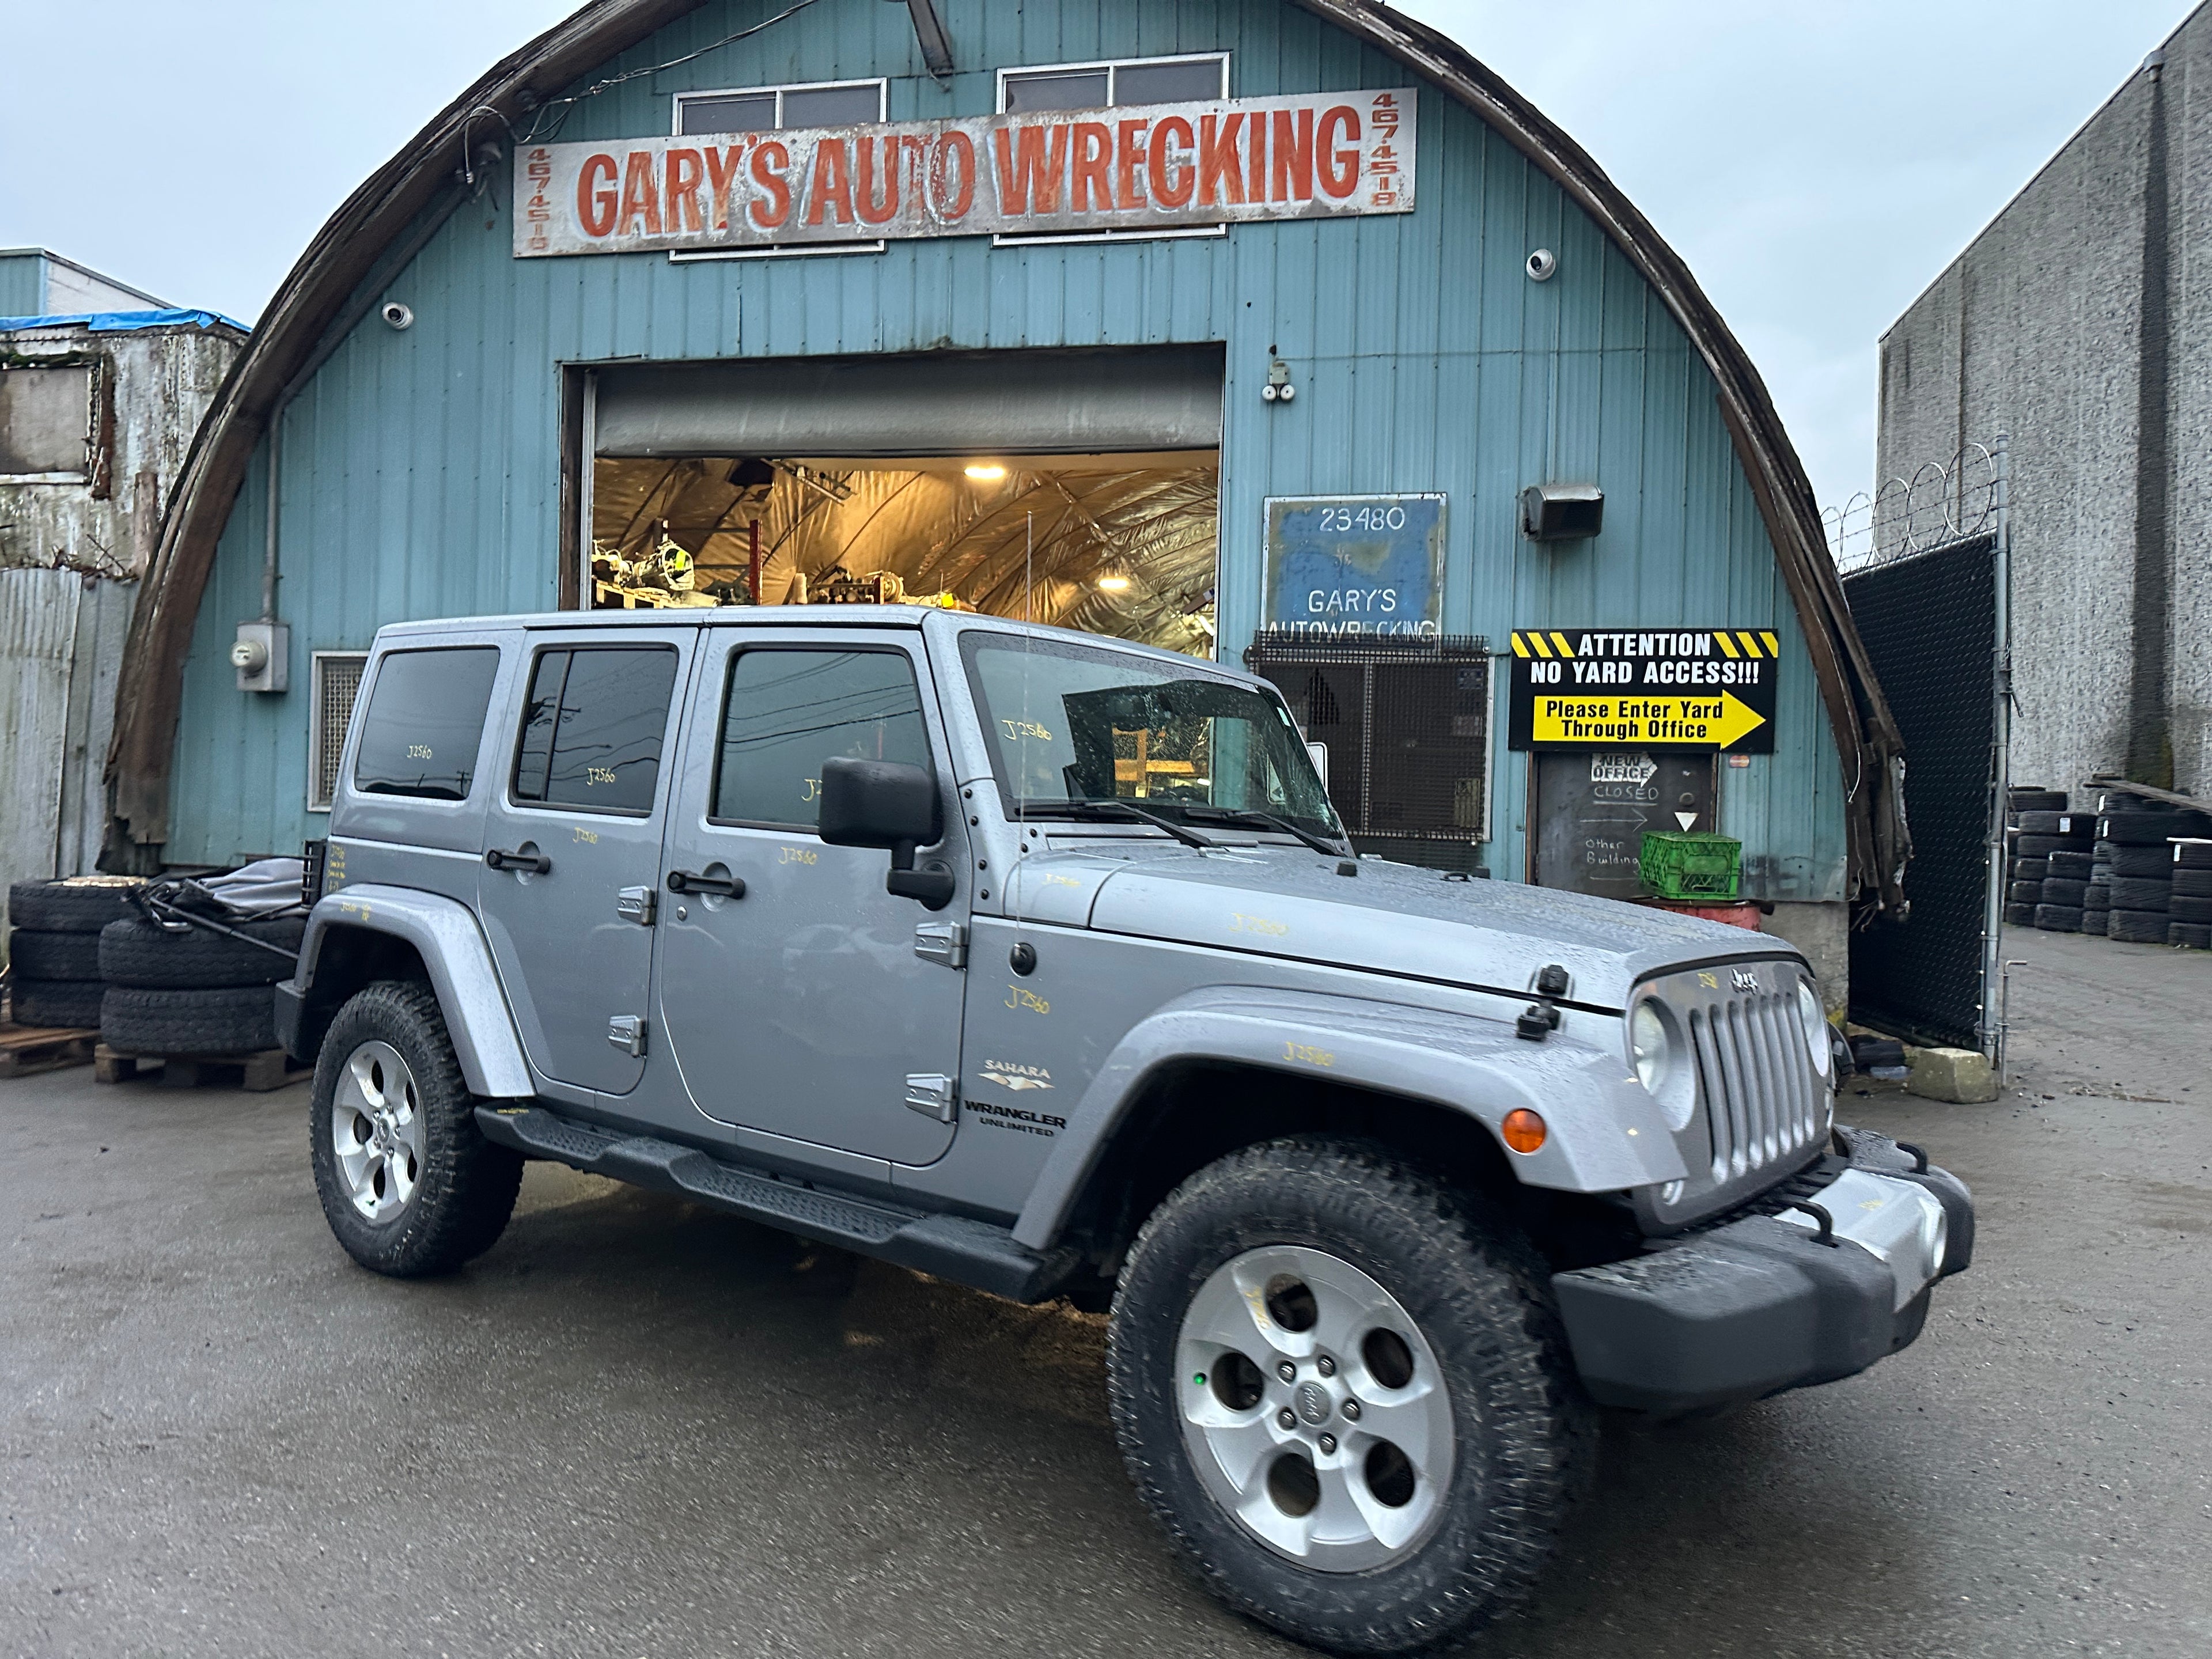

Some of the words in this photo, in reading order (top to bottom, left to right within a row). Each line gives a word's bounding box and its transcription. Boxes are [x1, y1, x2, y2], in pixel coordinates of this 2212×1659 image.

[578, 135, 790, 236] GARY'S
[808, 130, 975, 226] AUTO
[995, 105, 1361, 216] WRECKING
[1320, 507, 1406, 532] 23480
[1308, 588, 1396, 612] GARY'S
[1578, 633, 1711, 656] ATTENTION
[1531, 661, 1561, 684] NO
[1573, 661, 1633, 684] YARD
[1643, 661, 1759, 684] ACCESS!!!
[1546, 700, 1608, 718] Please
[1619, 700, 1671, 718] Enter
[1681, 701, 1723, 718] Yard
[1561, 720, 1638, 740] Through
[1648, 721, 1706, 737] Office
[1601, 755, 1640, 767] NEW
[1593, 766, 1650, 779] OFFICE
[1585, 839, 1624, 849] Other
[1587, 851, 1641, 874] Building
[984, 1059, 1051, 1080] SAHARA
[964, 1100, 1067, 1130] WRANGLER
[979, 1116, 1055, 1137] UNLIMITED
